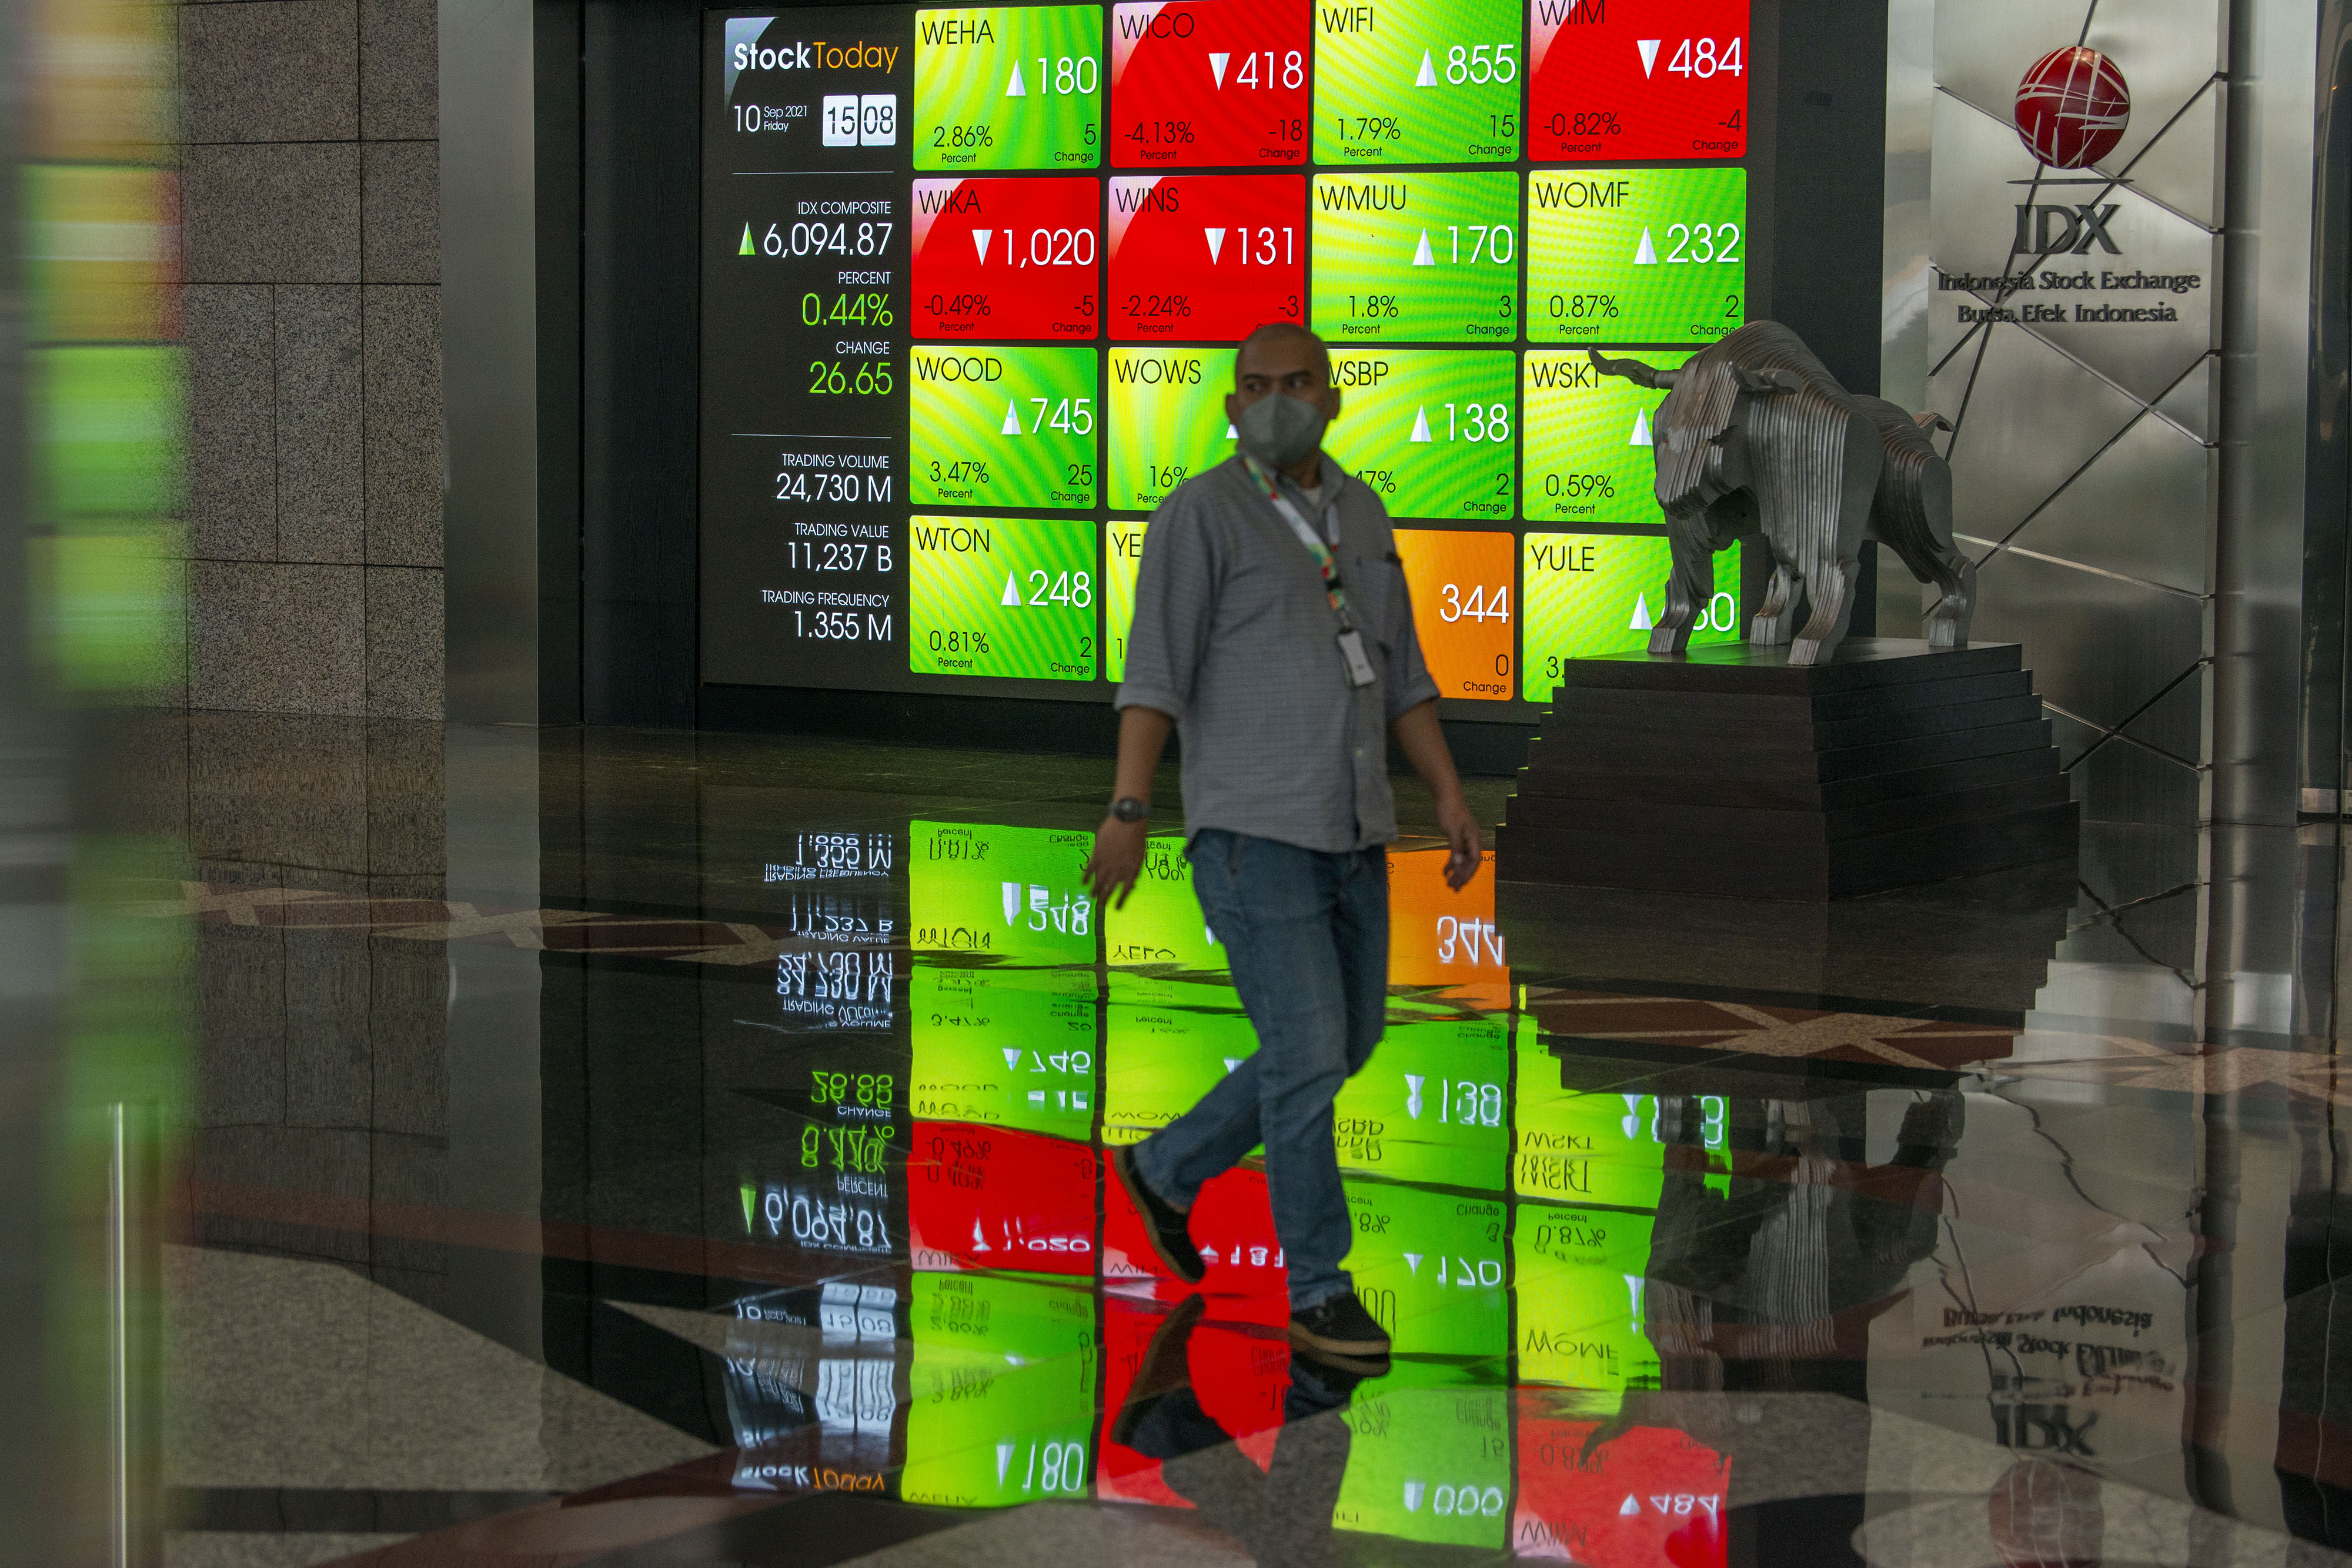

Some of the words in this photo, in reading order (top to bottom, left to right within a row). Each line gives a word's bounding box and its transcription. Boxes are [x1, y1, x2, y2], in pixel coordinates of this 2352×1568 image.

[1322, 7, 1373, 33] WIFI
[1539, 0, 1604, 25] WIIM
[922, 20, 994, 45] WEHA
[1120, 12, 1194, 40] WICO
[1446, 44, 1515, 85] 855
[1668, 38, 1742, 78] 484
[1038, 56, 1097, 95] 180
[1237, 51, 1303, 89] 418
[734, 105, 760, 132] 10
[764, 106, 784, 119] Sep
[786, 105, 807, 117] 2021
[827, 106, 856, 134] 15
[864, 105, 893, 135] 08
[1719, 109, 1741, 132] -4
[764, 122, 789, 132] Friday
[1084, 124, 1096, 145] 5
[1124, 122, 1194, 144] -4.13%
[1269, 119, 1302, 142] -18
[1338, 118, 1401, 140] 1.79%
[1491, 115, 1514, 138] 15
[1544, 113, 1621, 136] -0.82%
[933, 125, 993, 148] 2.86%
[1561, 143, 1601, 152] Percent
[1693, 140, 1738, 151] Change
[941, 153, 976, 163] Percent
[1054, 151, 1094, 162] Change
[1140, 150, 1177, 160] Percent
[1259, 148, 1300, 159] Change
[1344, 146, 1382, 156] Percent
[1469, 145, 1511, 156] Change
[919, 190, 981, 214] WIKA
[1116, 188, 1179, 212] WINS
[1320, 185, 1406, 211] WMUU
[1536, 182, 1629, 208] WOMF
[799, 202, 817, 215] IDX
[821, 202, 891, 215] COMPOSITE
[764, 222, 893, 258] 6,094.87
[2014, 204, 2122, 255] IDX
[1004, 228, 1095, 268] 1,020
[1238, 228, 1292, 265] 131
[1448, 225, 1514, 264] 170
[1667, 223, 1740, 263] 232
[838, 272, 891, 284] PERCENT
[1938, 273, 2034, 290] Indonesia
[2039, 272, 2095, 290] Stock
[2101, 272, 2200, 293] Exchange
[803, 293, 893, 326] 0.44%
[924, 295, 991, 316] -0.49%
[1074, 296, 1094, 316] -5
[1121, 295, 1191, 317] -2.24%
[1279, 295, 1299, 317] -3
[1349, 295, 1398, 317] 1.8%
[1499, 295, 1511, 317] 3
[1549, 295, 1619, 318] 0.87%
[1726, 295, 1739, 317] 2
[1957, 305, 2013, 323] Bursa
[2023, 304, 2066, 323] Efek
[2075, 302, 2177, 322] Indonesia
[940, 322, 974, 332] Percent
[1053, 323, 1091, 333] Change
[1137, 323, 1174, 333] Percent
[1342, 324, 1380, 335] Percent
[1466, 325, 1509, 335] Change
[1559, 325, 1599, 335] Percent
[836, 342, 890, 354] CHANGE
[810, 361, 893, 395] 26.65
[917, 357, 1002, 382] WOOD
[1115, 359, 1201, 385] WOWS
[1030, 397, 1092, 435] 745
[1445, 402, 1510, 443] 138
[783, 453, 835, 467] TRADING
[838, 455, 889, 469] VOLUME
[930, 460, 989, 483] 3.47%
[1068, 464, 1092, 485] 25
[1496, 473, 1509, 495] 2
[776, 473, 859, 503] 24,730
[868, 476, 891, 503] M
[938, 488, 973, 499] Percent
[1546, 474, 1615, 498] 0.59%
[1051, 492, 1090, 503] Change
[1137, 494, 1164, 503] Perce
[1464, 502, 1506, 514] Change
[1555, 504, 1595, 514] Percent
[795, 523, 847, 537] TRADING
[851, 525, 888, 538] VALUE
[916, 527, 990, 553] WTON
[789, 541, 867, 571] 11,237
[878, 545, 892, 571] B
[1531, 546, 1594, 571] YULE
[763, 590, 814, 604] TRADING
[818, 592, 889, 607] FREQUENCY
[1029, 570, 1091, 608] 248
[1440, 584, 1509, 624] 344
[794, 610, 859, 640] 1.355
[869, 614, 891, 641] M
[930, 630, 989, 653] 0.81%
[1081, 637, 1091, 658] 2
[938, 658, 973, 668] Percent
[1051, 663, 1090, 674] Change
[1495, 654, 1509, 677] 0
[1464, 681, 1506, 694] Change
